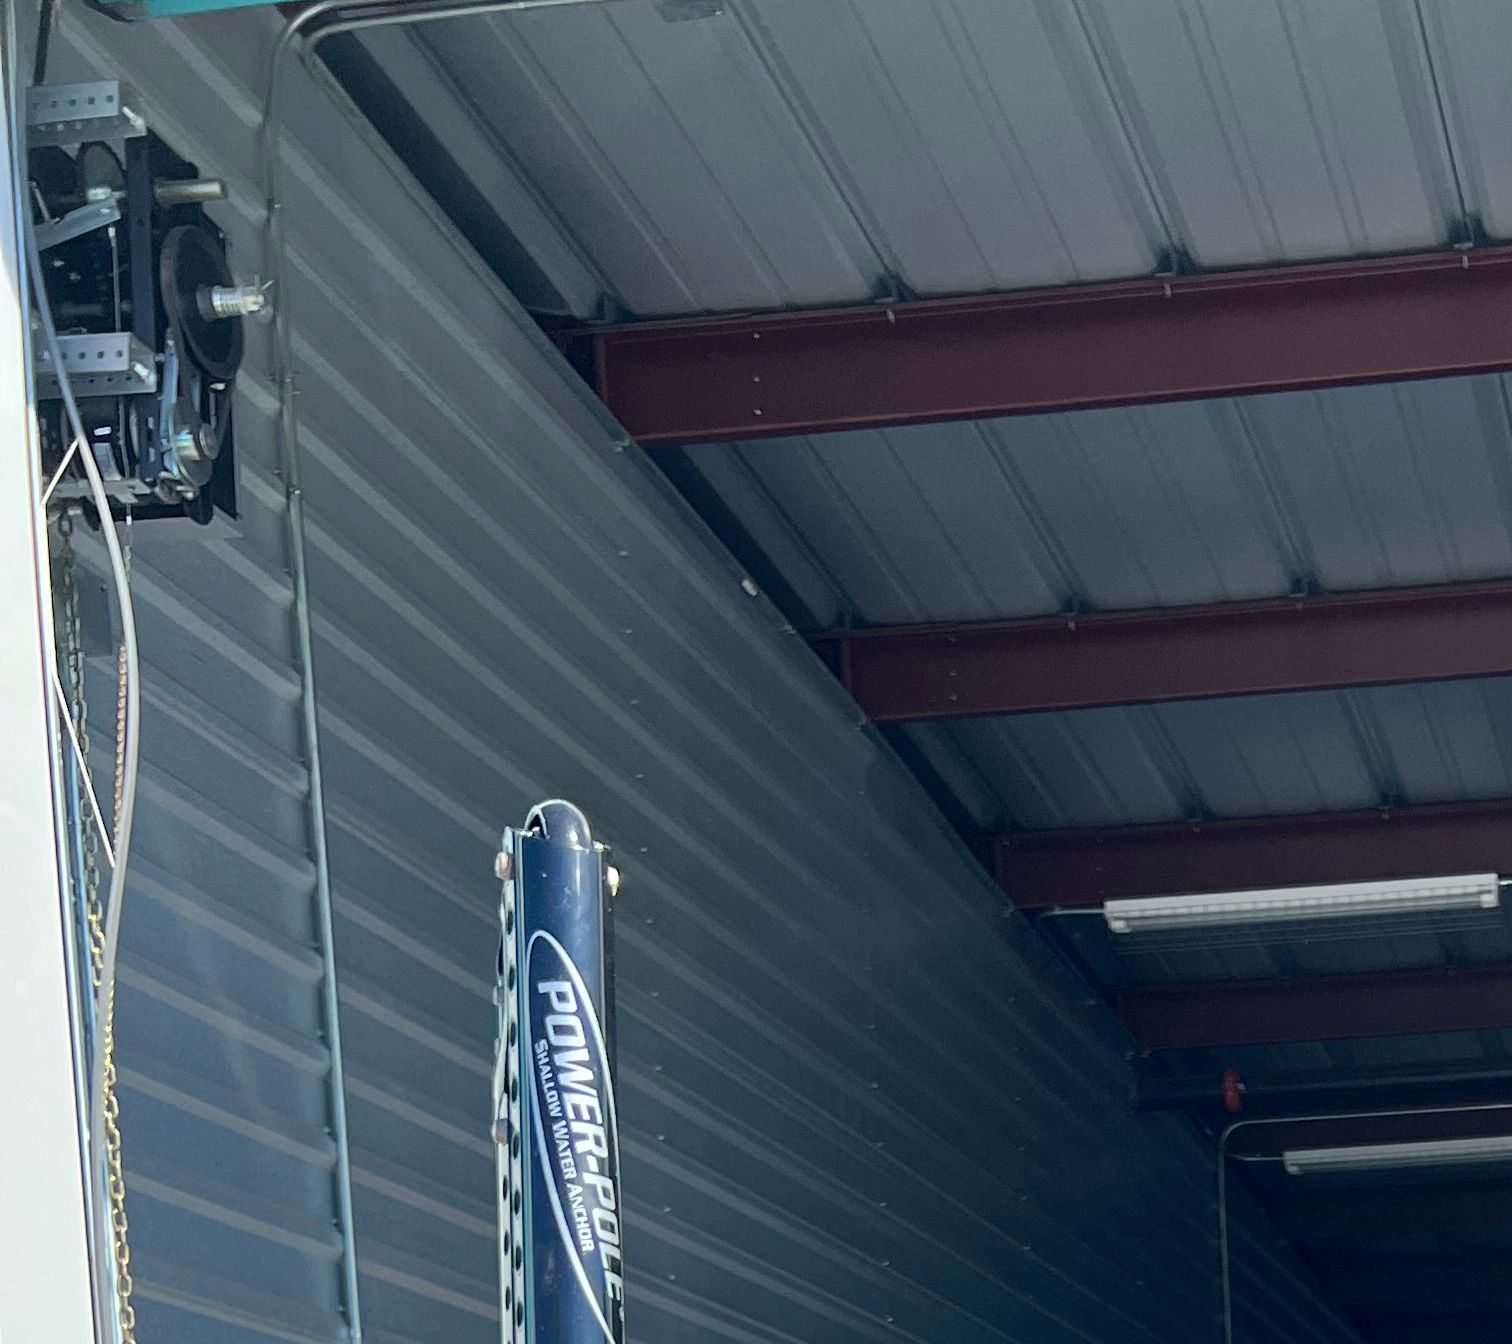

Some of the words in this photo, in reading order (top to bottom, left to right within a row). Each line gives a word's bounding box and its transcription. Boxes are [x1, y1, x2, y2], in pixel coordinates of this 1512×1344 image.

[533, 1038, 563, 1118] SHALLOW
[551, 1118, 576, 1182] WATER
[566, 1182, 594, 1254] ANCHOR
[537, 980, 624, 1301] POWER-POLE
